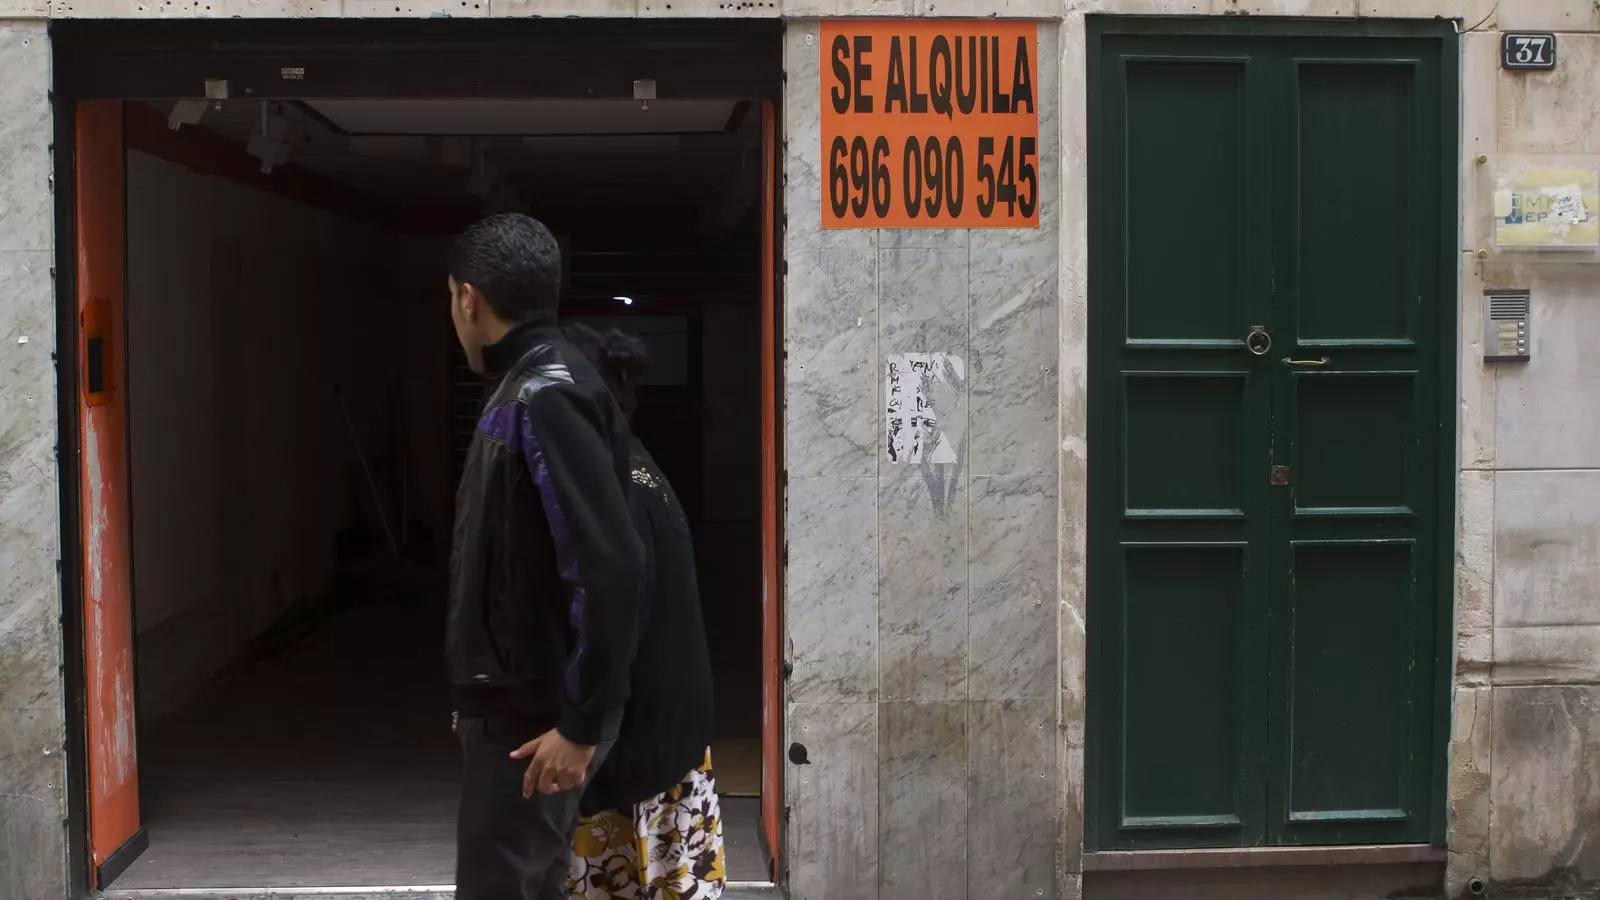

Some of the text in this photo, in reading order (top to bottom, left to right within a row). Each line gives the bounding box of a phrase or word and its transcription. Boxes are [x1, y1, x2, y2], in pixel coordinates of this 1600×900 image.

[831, 34, 1034, 121] SE ALQUILA
[1515, 38, 1546, 63] 37
[829, 135, 1037, 219] 696 090 545
